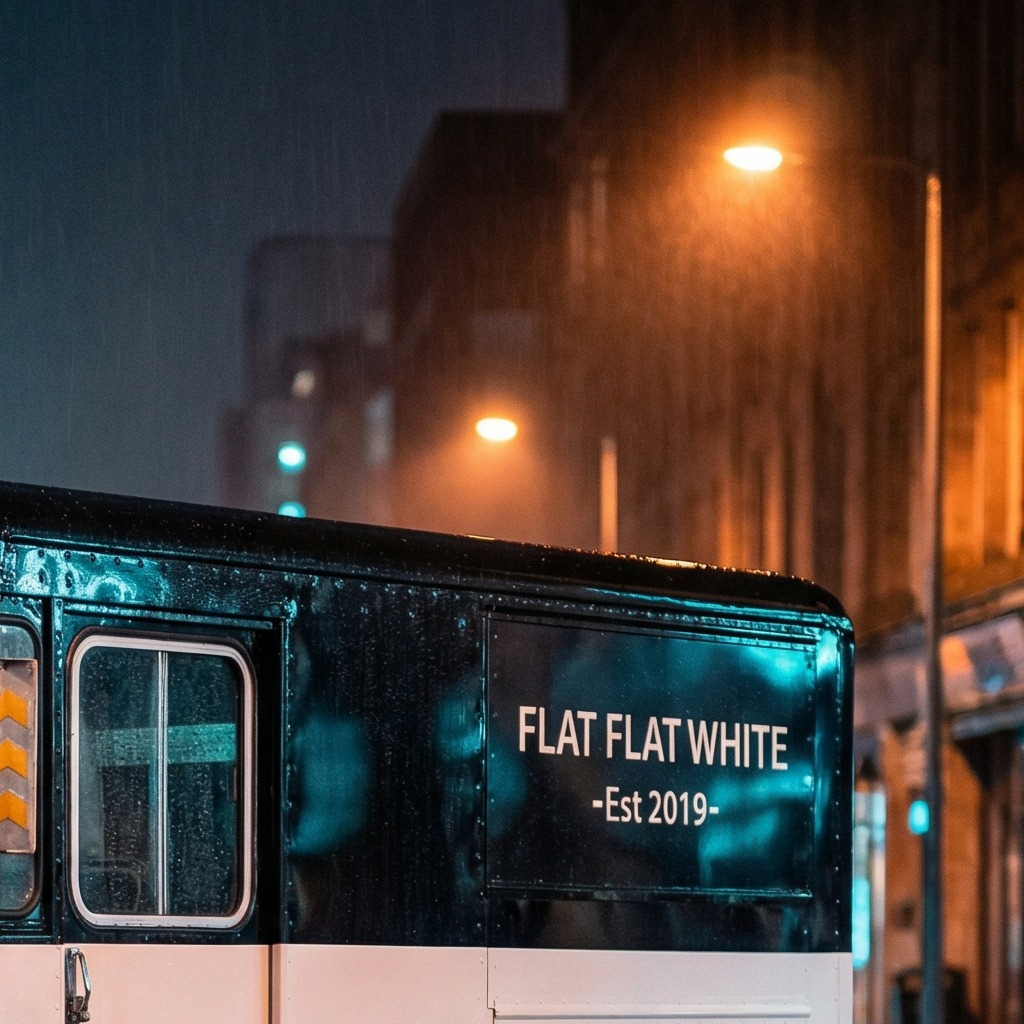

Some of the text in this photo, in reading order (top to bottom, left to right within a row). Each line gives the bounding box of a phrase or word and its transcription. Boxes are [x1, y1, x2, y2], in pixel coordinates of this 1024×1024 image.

[519, 705, 788, 770] FLAT FLAT WHITE
[592, 786, 719, 826] -Est 2019-
